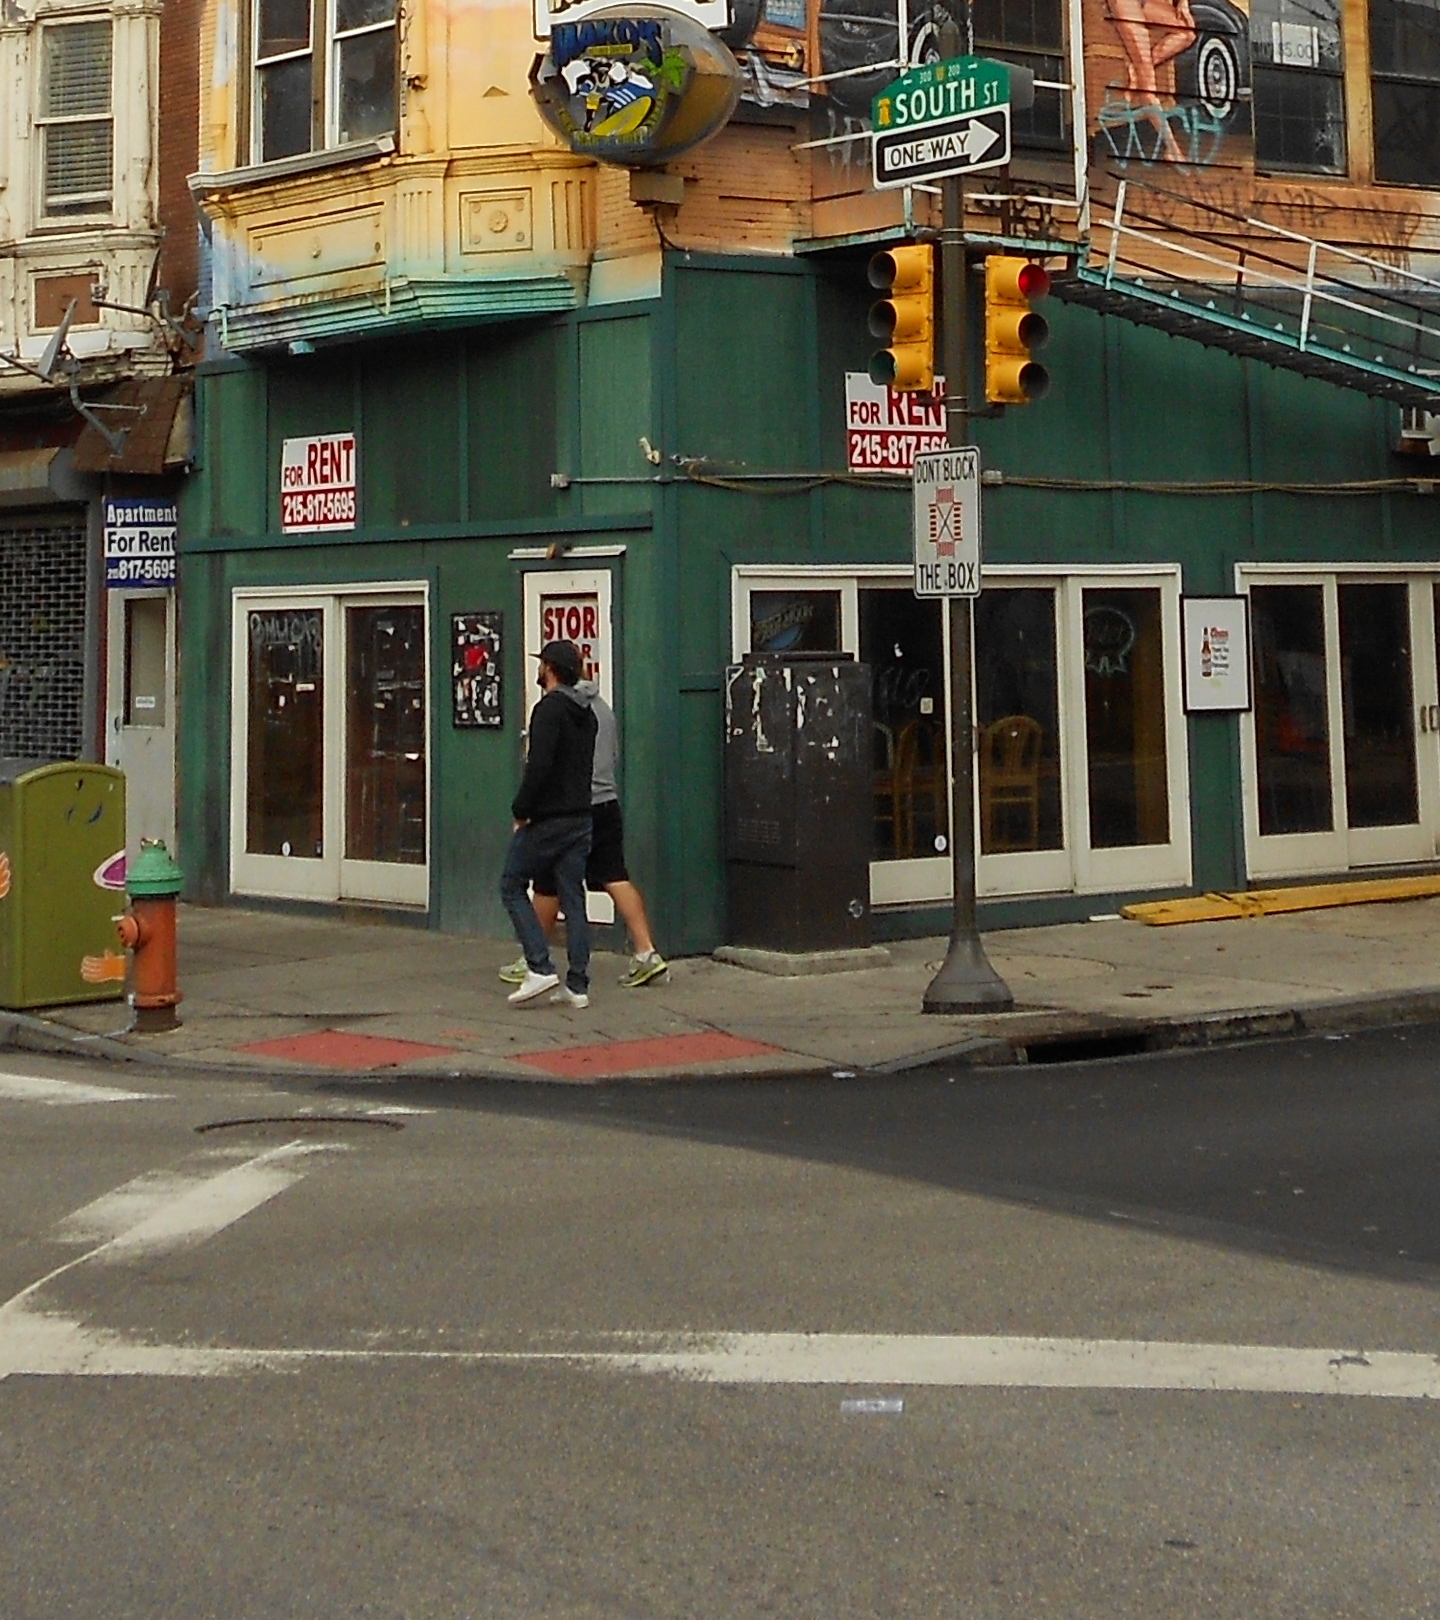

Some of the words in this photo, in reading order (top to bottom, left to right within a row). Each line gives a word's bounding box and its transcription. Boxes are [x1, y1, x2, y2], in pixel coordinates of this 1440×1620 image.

[947, 64, 961, 77] 200
[895, 77, 975, 125] SOUTH
[983, 80, 999, 105] ST
[890, 143, 926, 168] ONE
[929, 133, 970, 159] WAY
[849, 401, 881, 425] FOR
[283, 465, 304, 487] FOR
[307, 439, 354, 486] RENT
[916, 459, 941, 484] DONT
[943, 455, 976, 481] BLOCK
[107, 503, 177, 527] Apartment
[283, 491, 356, 523] 215-817-5695
[107, 531, 136, 553] For
[138, 530, 176, 553] Rent
[918, 563, 942, 590] THE
[947, 562, 975, 590] BOX
[543, 606, 599, 641] STOR
